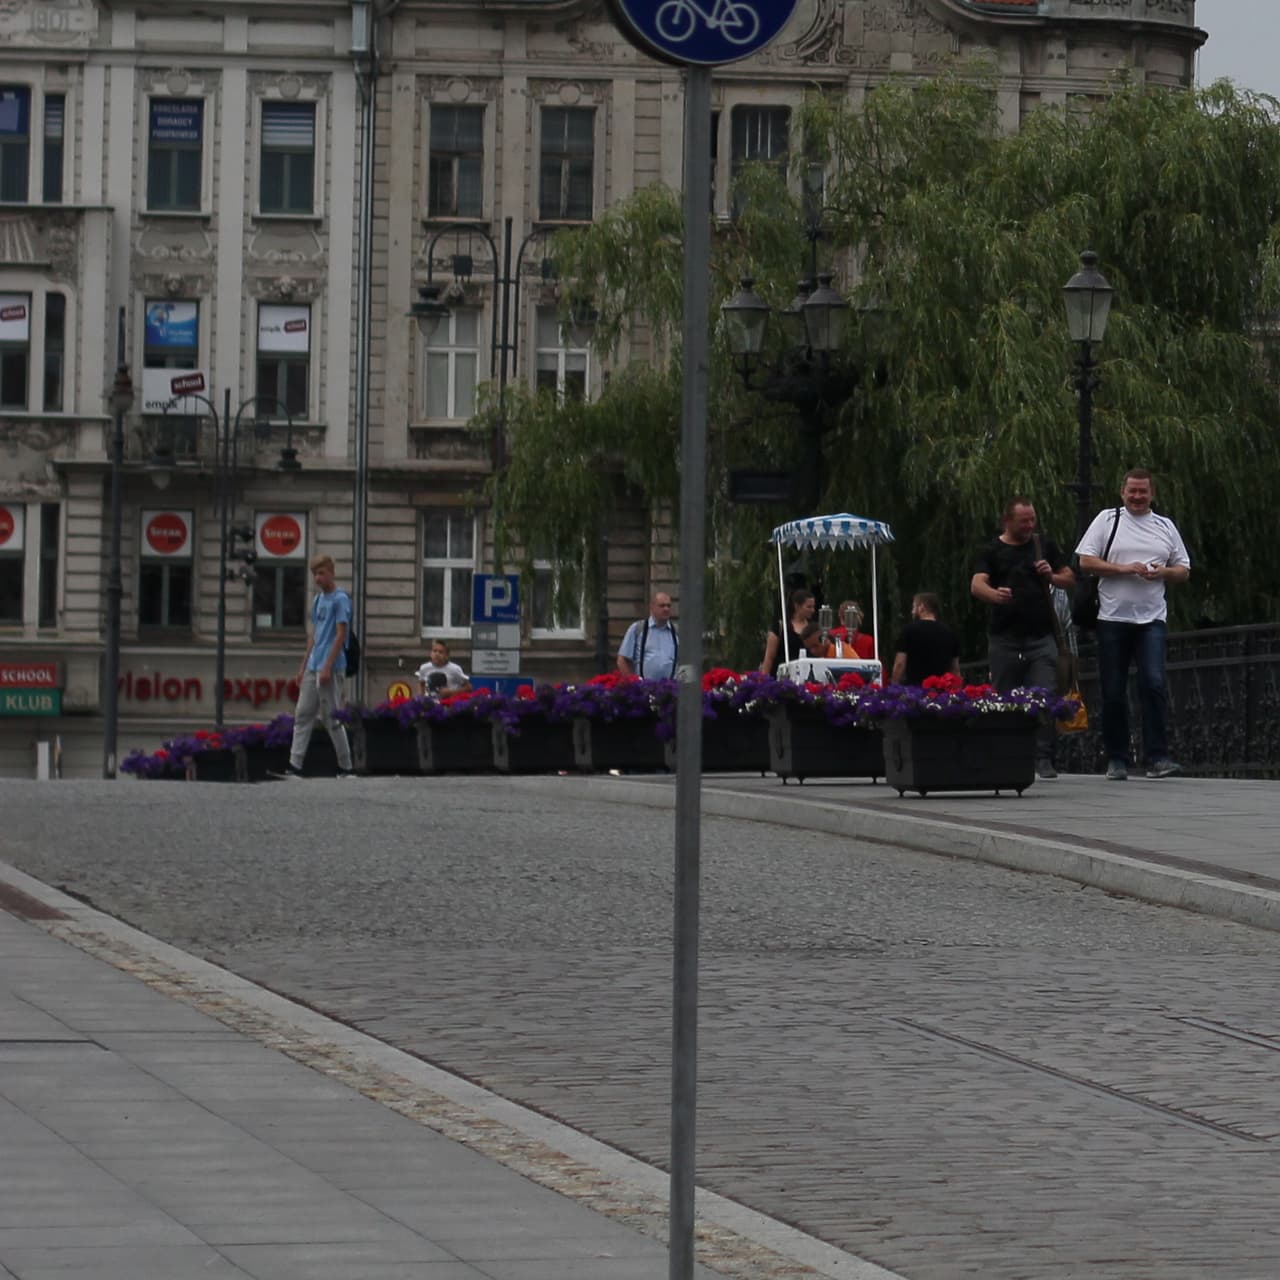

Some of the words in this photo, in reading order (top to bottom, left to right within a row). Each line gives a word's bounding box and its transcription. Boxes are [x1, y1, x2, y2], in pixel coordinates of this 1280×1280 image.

[484, 579, 512, 617] P
[1, 670, 52, 683] SCHOOL
[6, 695, 53, 711] KLUB
